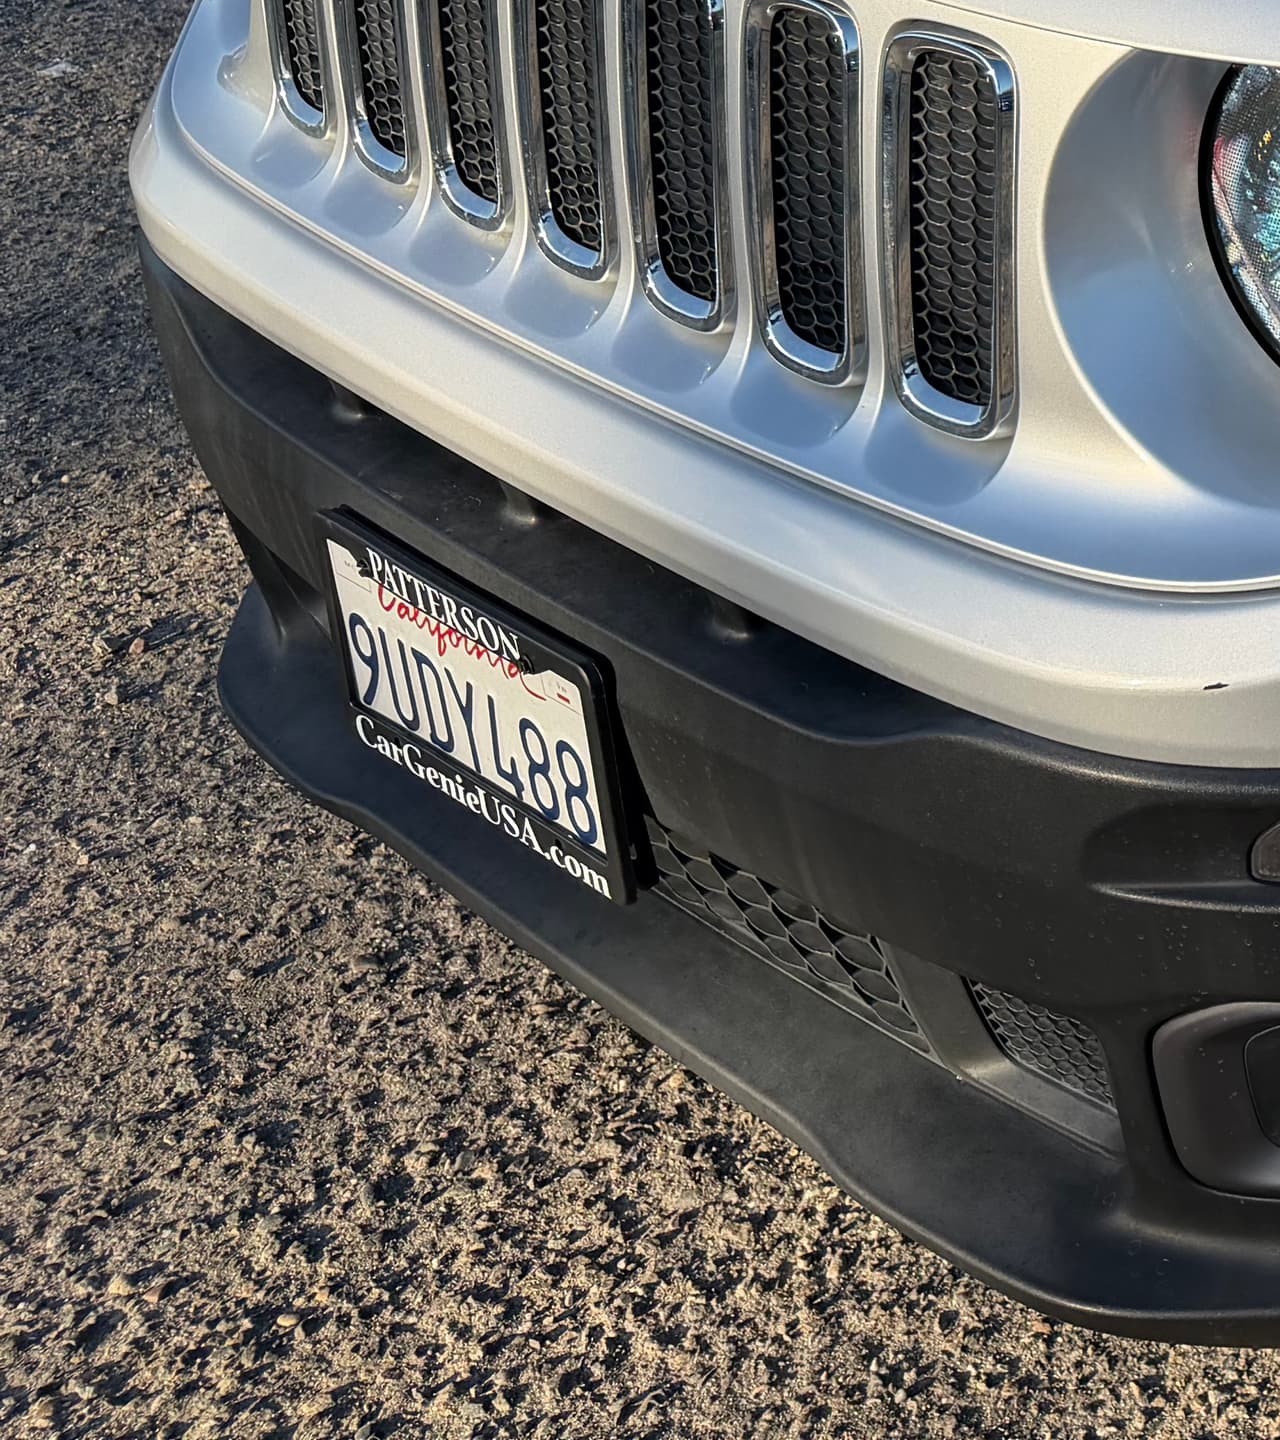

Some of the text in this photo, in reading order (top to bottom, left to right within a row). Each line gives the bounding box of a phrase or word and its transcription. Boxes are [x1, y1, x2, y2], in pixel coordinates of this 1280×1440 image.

[366, 547, 521, 661] PATTERSON
[349, 613, 598, 846] 9UDY488
[355, 714, 612, 900] CarGenieUSA.com
